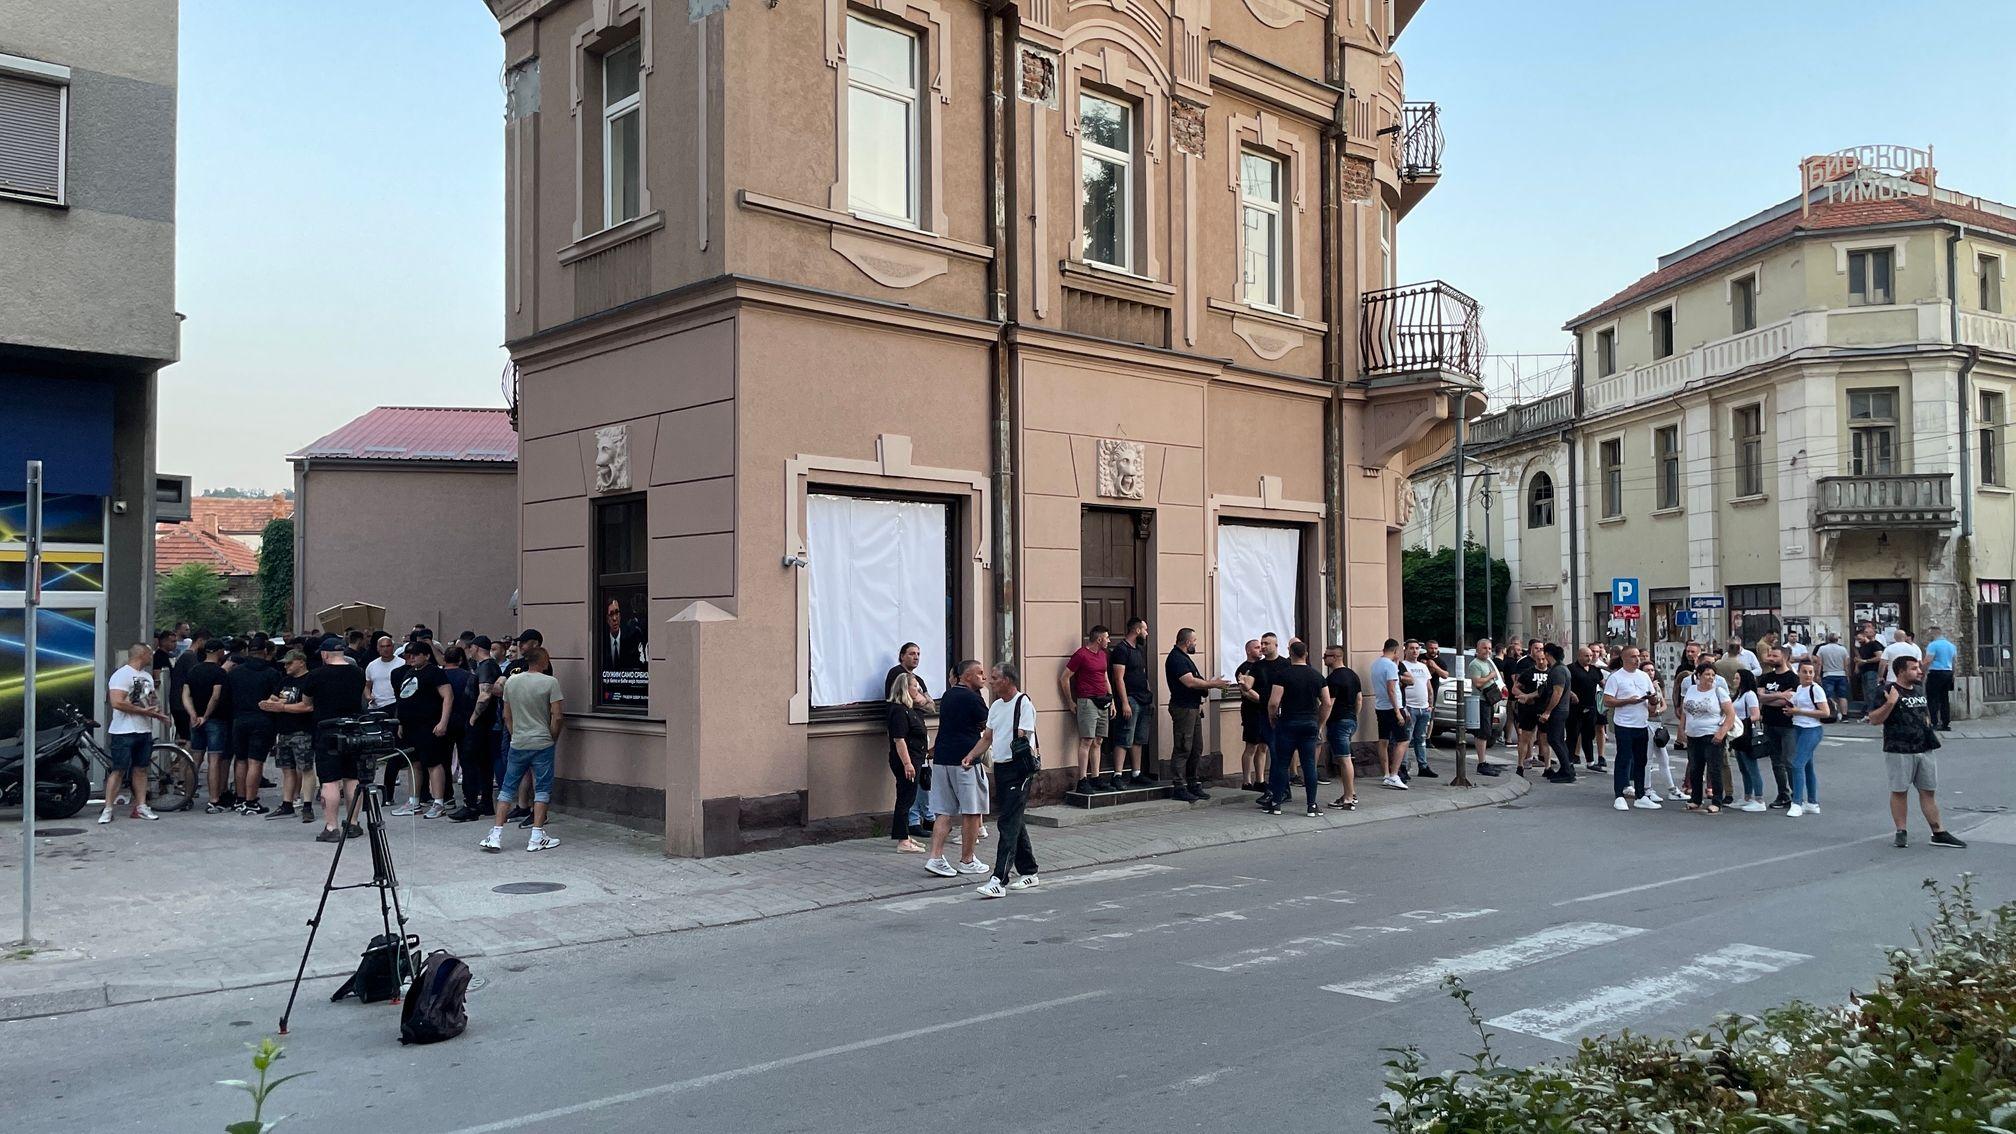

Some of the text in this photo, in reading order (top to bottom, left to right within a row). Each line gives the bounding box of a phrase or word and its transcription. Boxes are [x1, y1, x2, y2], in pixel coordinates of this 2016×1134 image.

[1807, 145, 1926, 189] БИОСКОП
[1618, 581, 1633, 602] P
[1532, 673, 1549, 682] JUS
